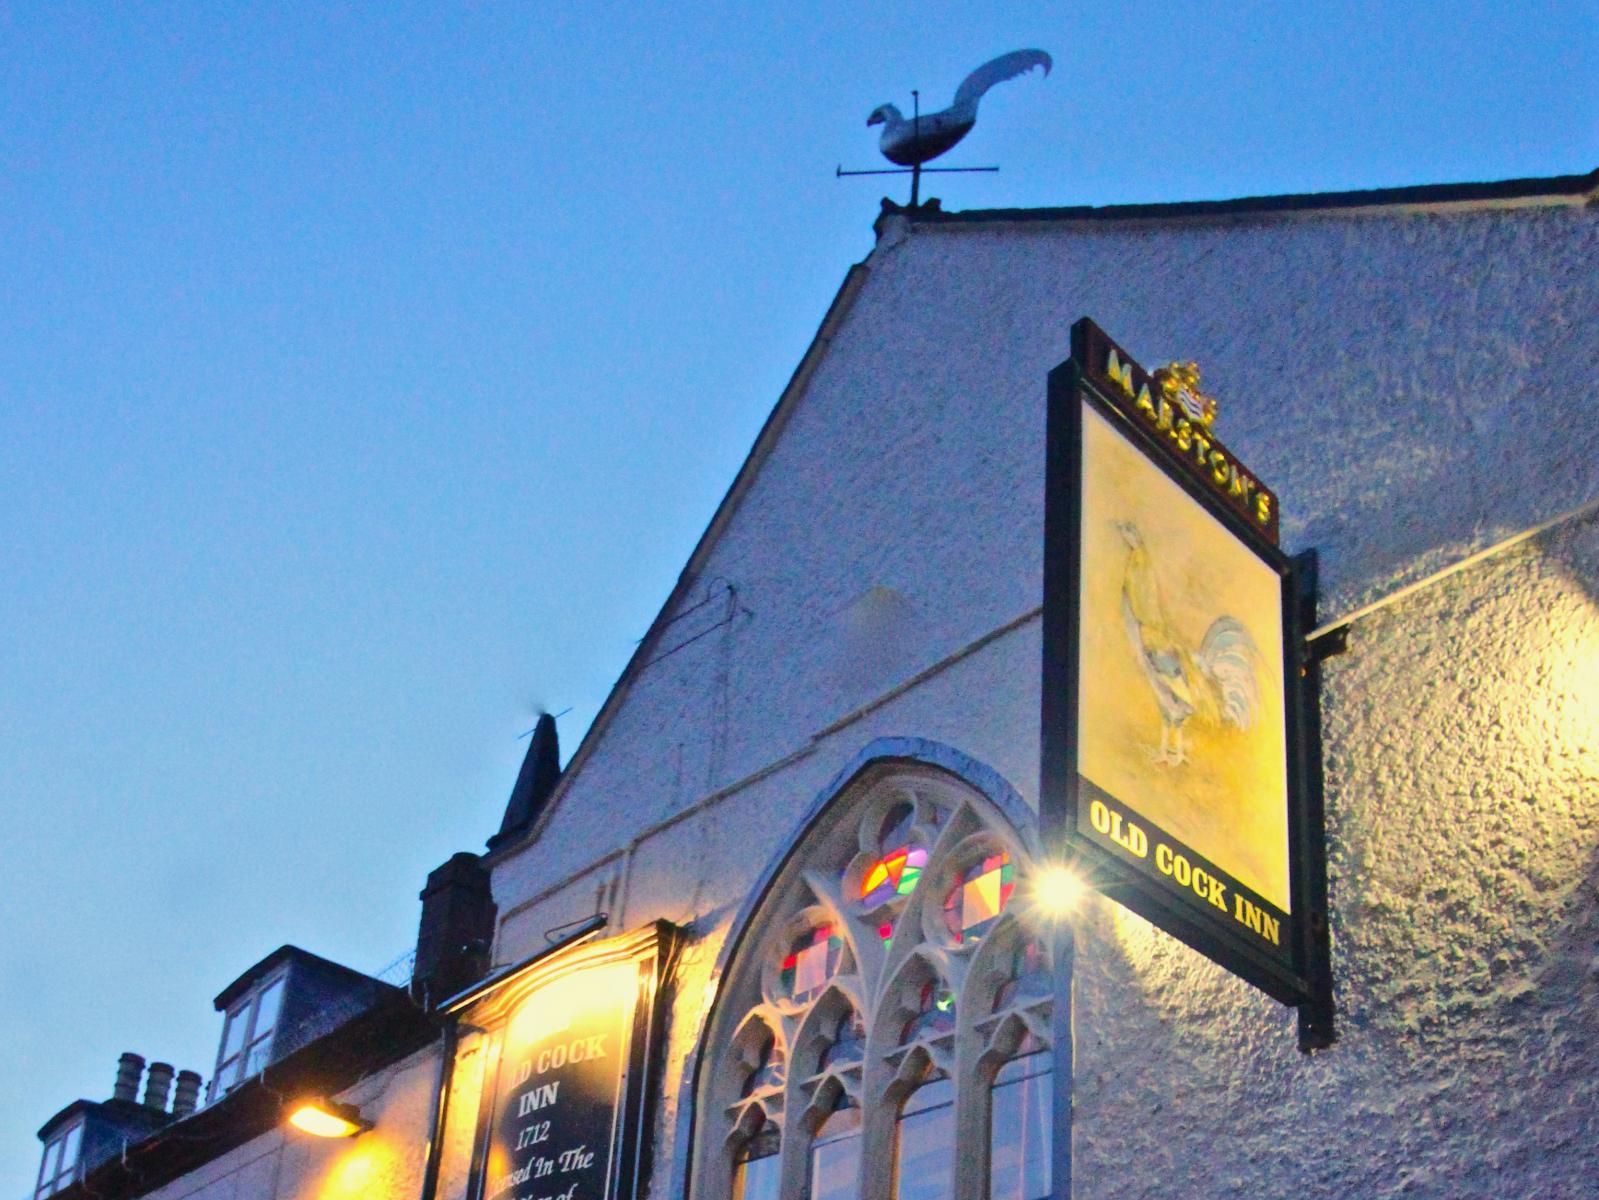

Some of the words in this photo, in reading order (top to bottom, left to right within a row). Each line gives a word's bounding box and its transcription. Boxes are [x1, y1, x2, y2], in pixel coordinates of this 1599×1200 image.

[1107, 348, 1271, 524] MARSTON'S
[1089, 800, 1149, 859] OLD
[1155, 842, 1229, 913] COCK
[1234, 892, 1281, 946] INN
[537, 1033, 608, 1075] COCK
[517, 1080, 560, 1118] INN
[515, 1120, 551, 1152] 1712
[534, 1157, 555, 1179] In
[558, 1144, 595, 1173] The
